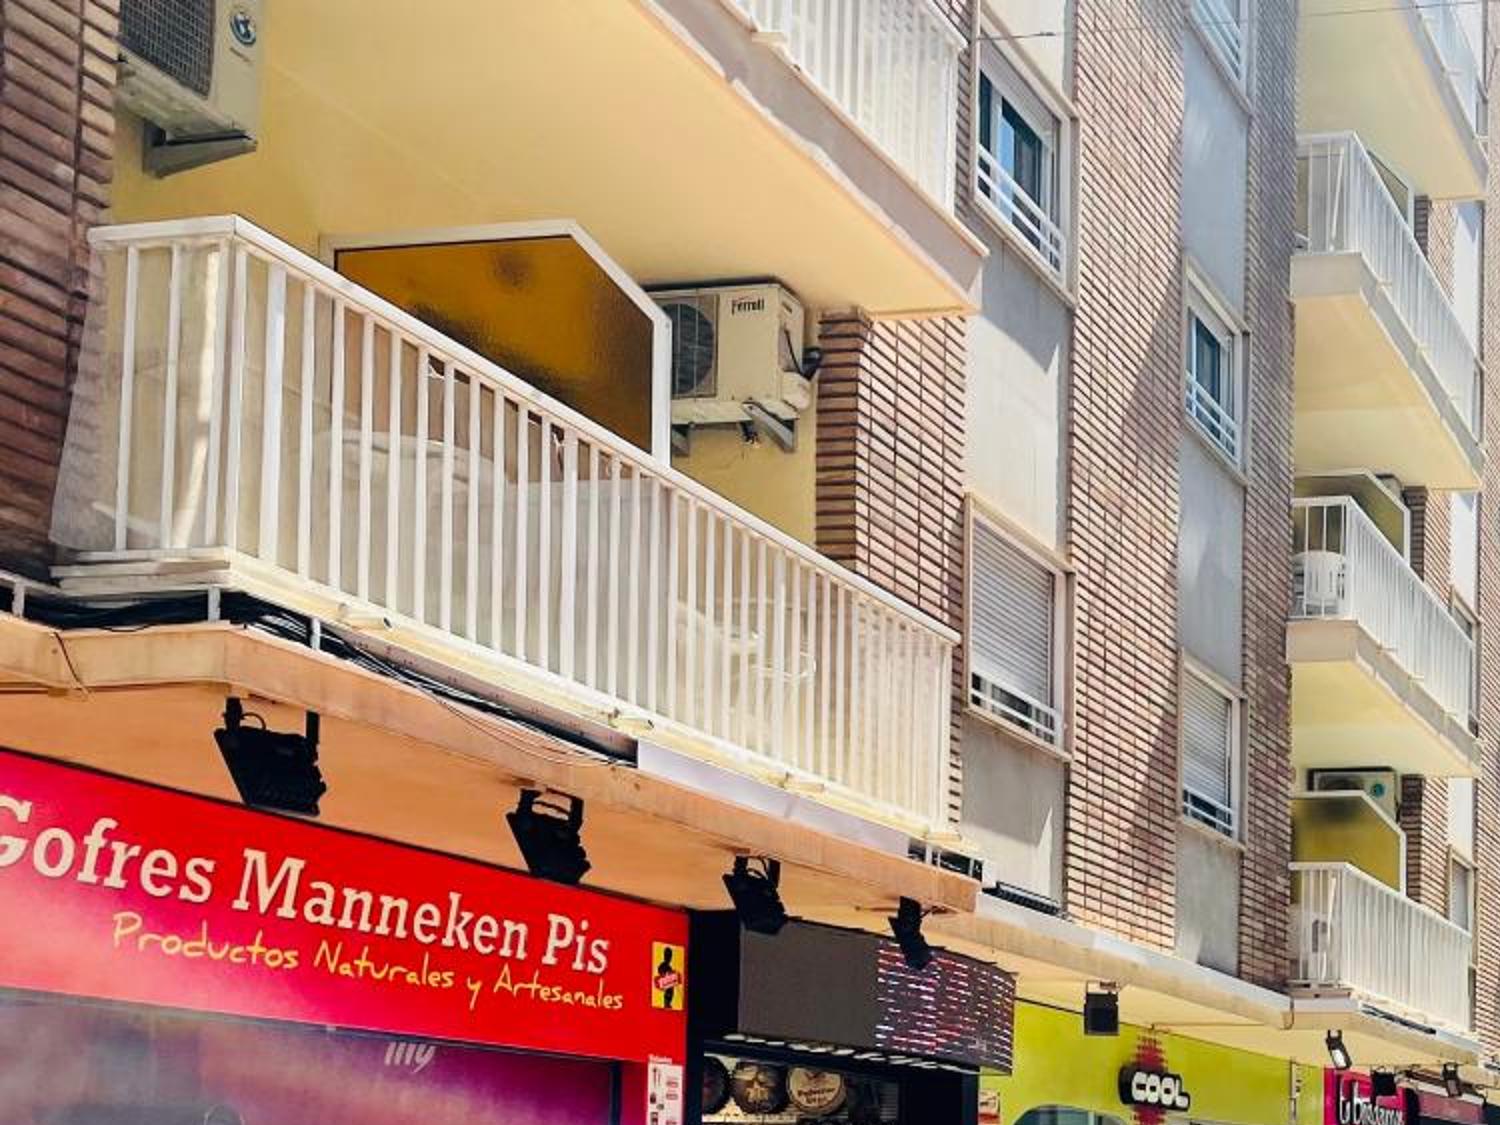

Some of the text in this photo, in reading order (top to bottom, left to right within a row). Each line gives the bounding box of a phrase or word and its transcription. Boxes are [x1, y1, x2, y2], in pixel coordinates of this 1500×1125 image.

[0, 794, 610, 974] Gofres Manneken Pis
[112, 911, 624, 1010] Productos Naturales y Artesanales
[1131, 1070, 1190, 1109] COOL
